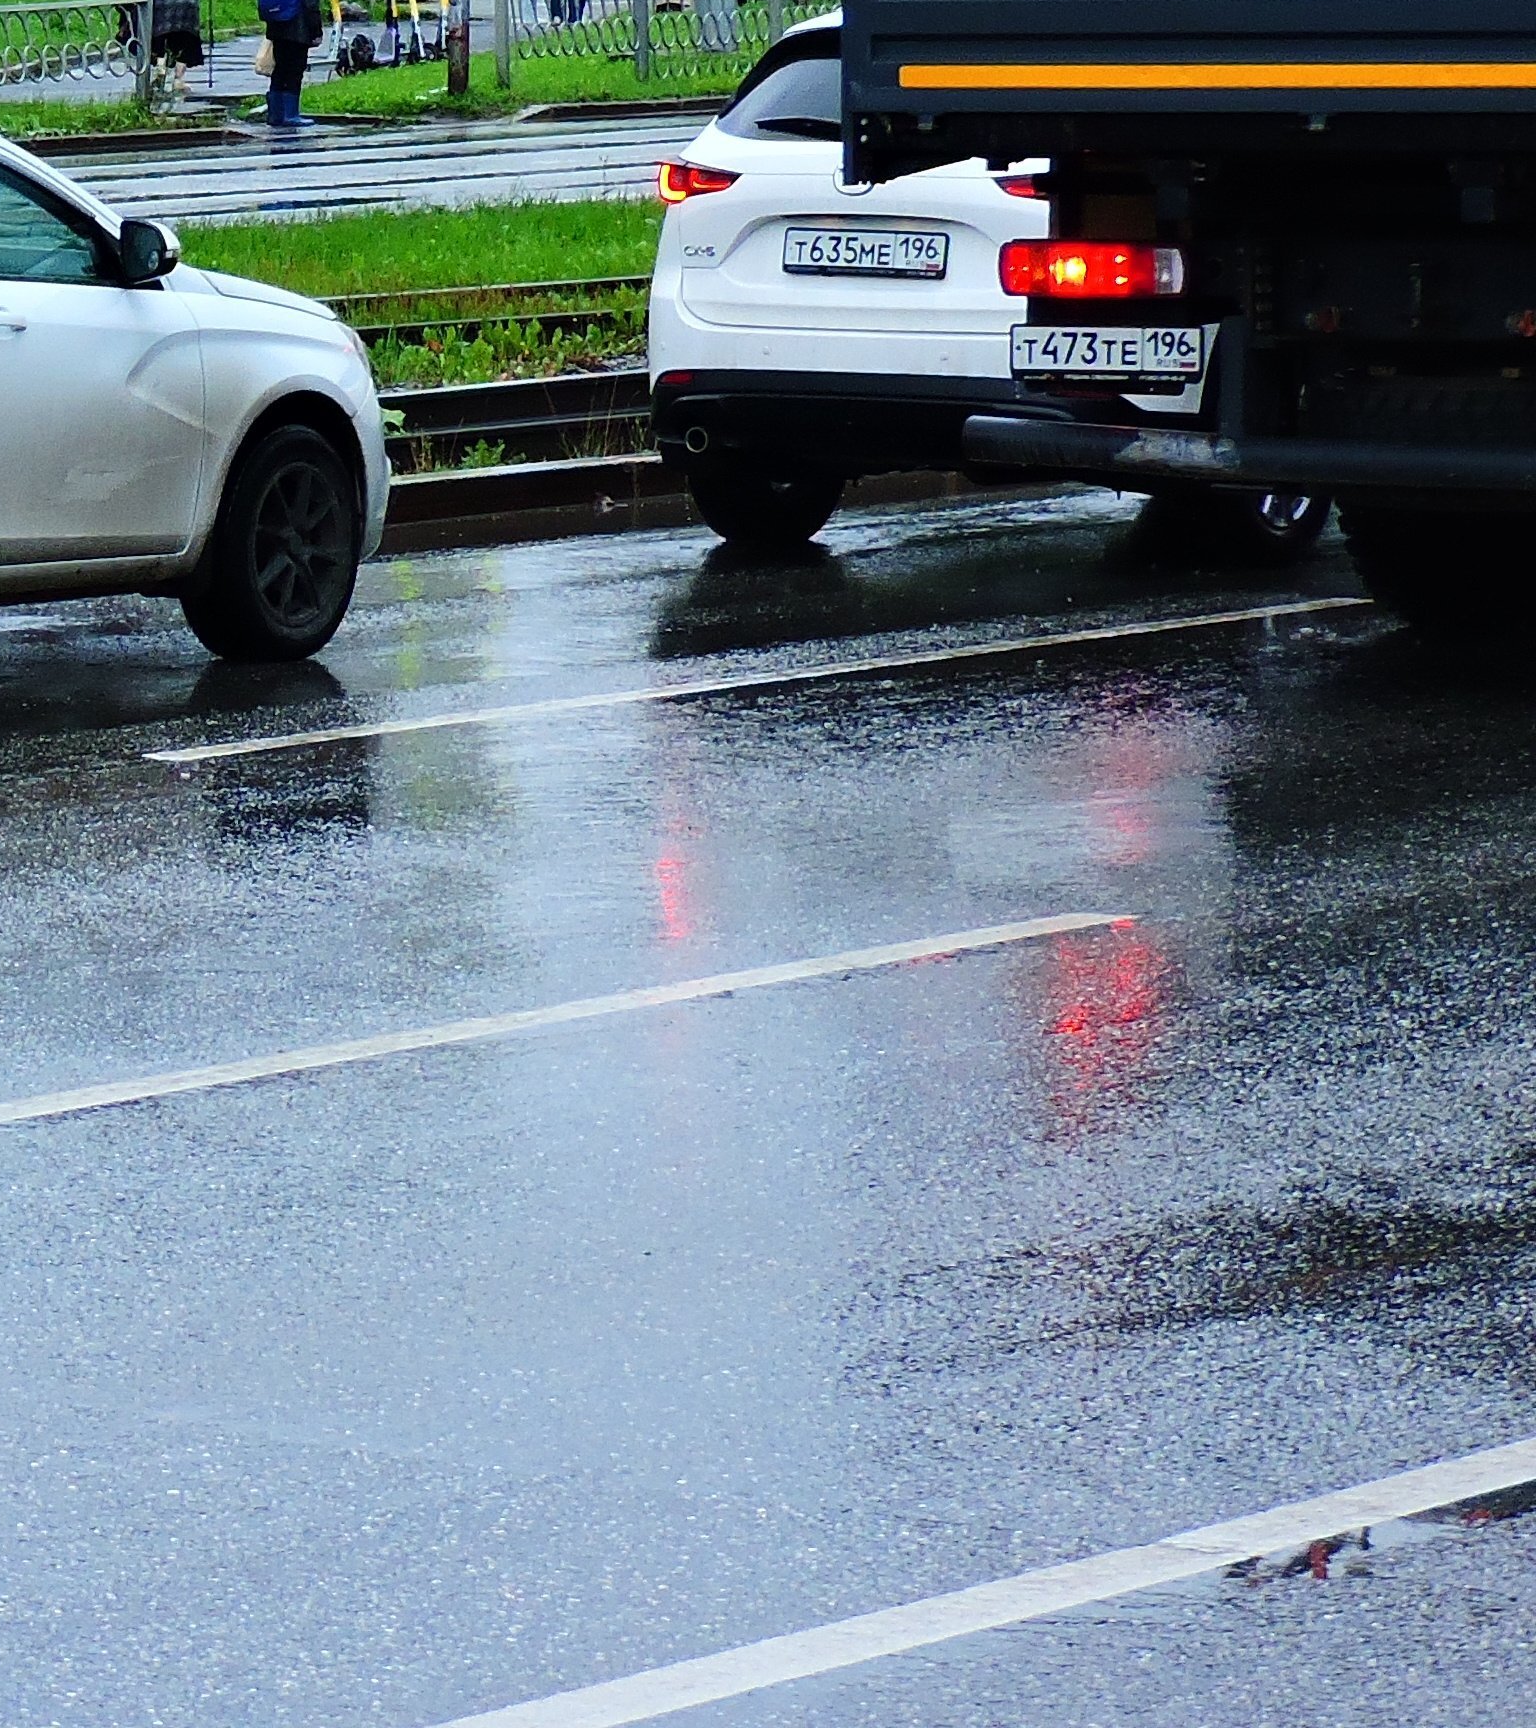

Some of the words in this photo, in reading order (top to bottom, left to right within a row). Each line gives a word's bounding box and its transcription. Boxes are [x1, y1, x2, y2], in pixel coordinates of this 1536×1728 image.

[794, 235, 891, 266] Т635МЕ
[899, 236, 938, 259] 196
[1023, 331, 1138, 366] Т473ТЕ
[1146, 331, 1191, 357] 196
